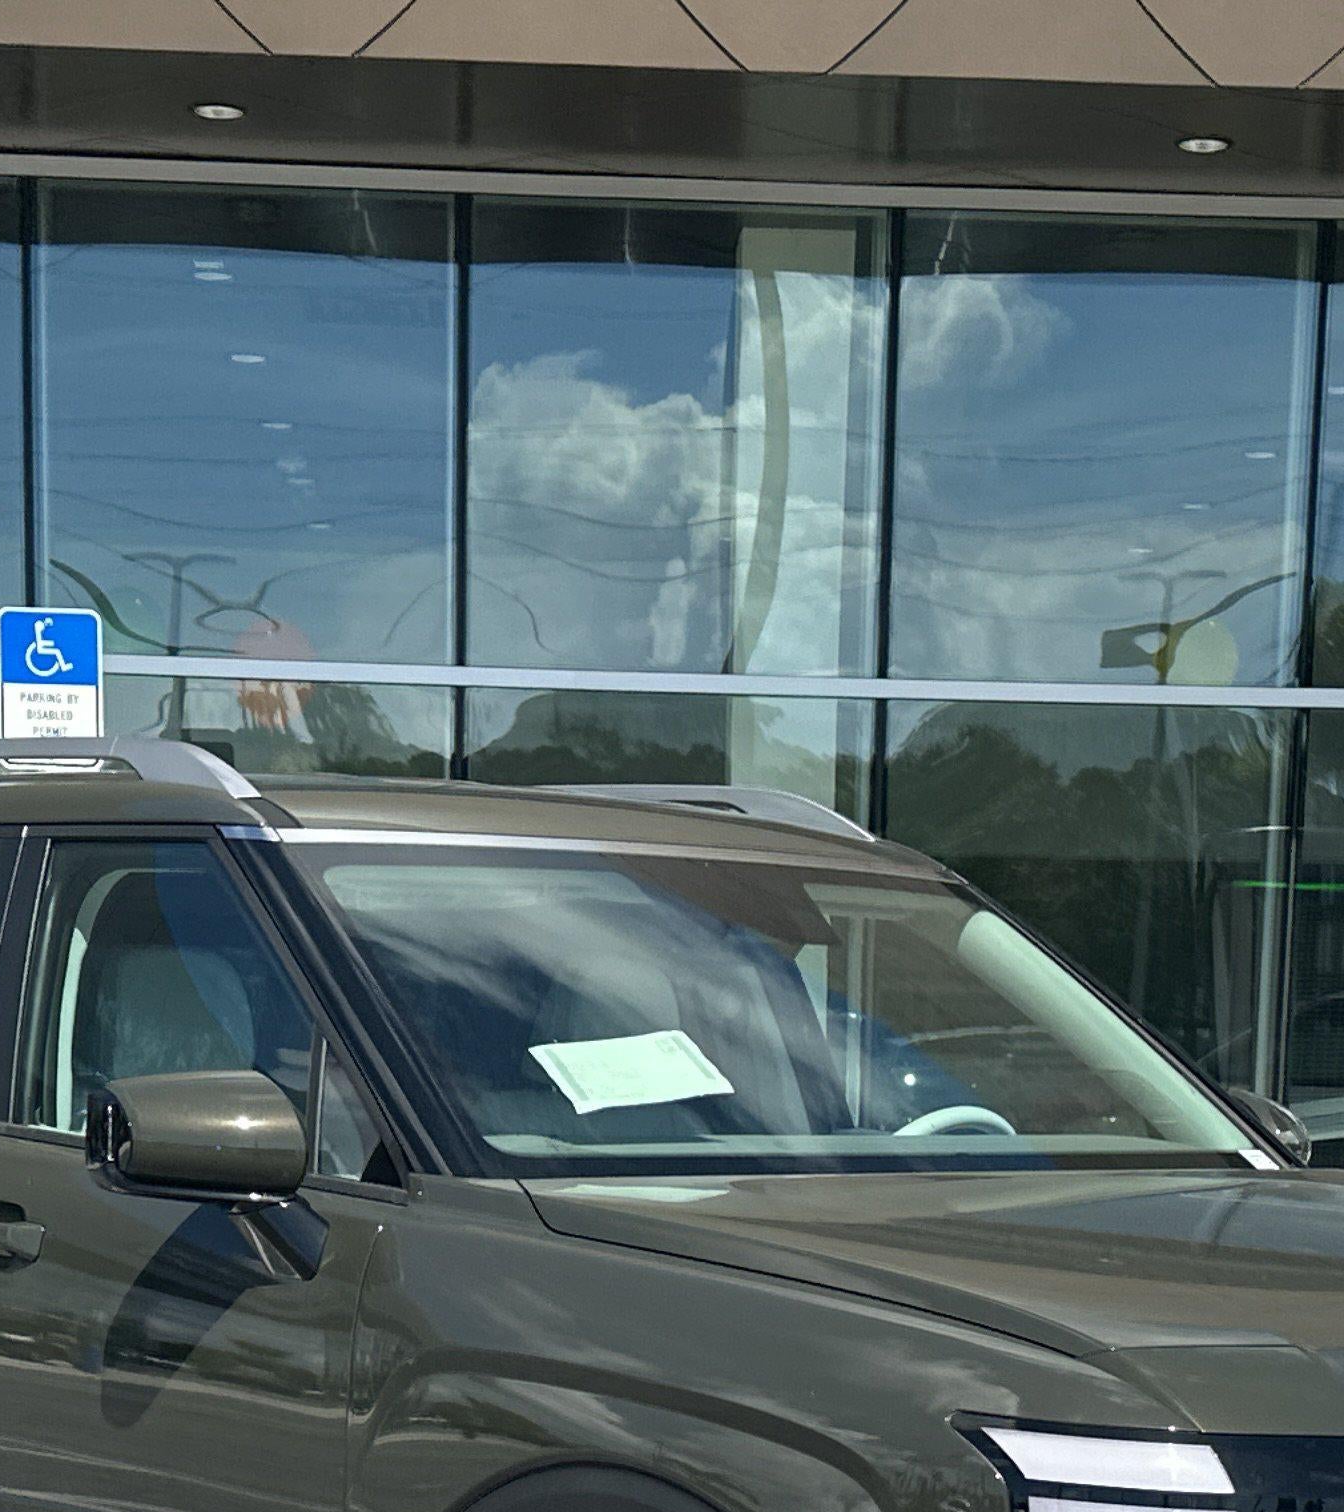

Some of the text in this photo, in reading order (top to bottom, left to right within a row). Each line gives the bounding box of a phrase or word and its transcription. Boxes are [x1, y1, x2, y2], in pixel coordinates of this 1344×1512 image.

[20, 692, 80, 704] PARKING BY
[27, 709, 73, 721] DISABLED
